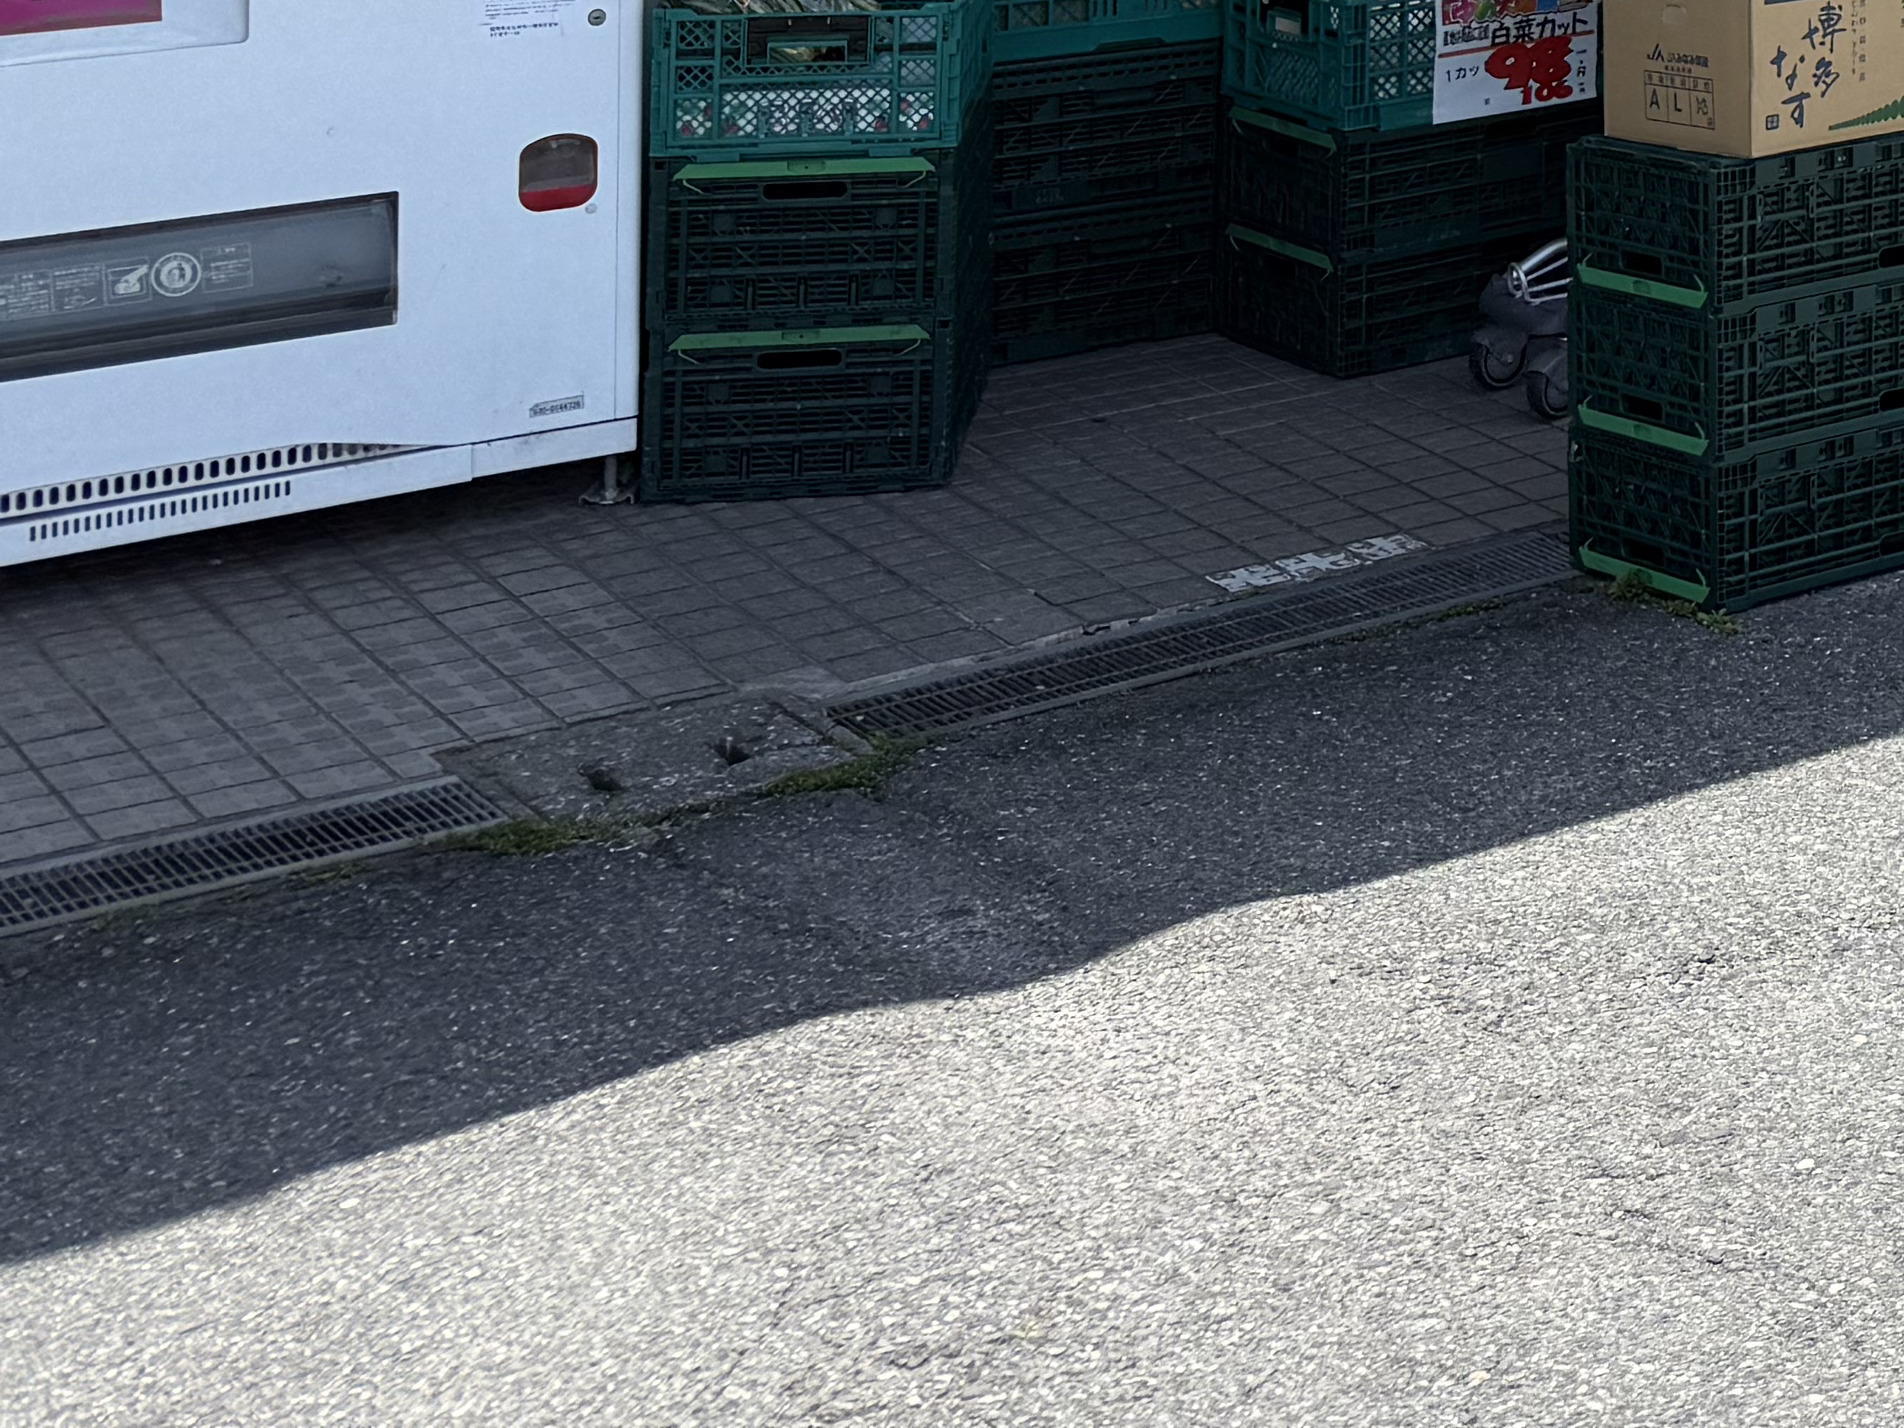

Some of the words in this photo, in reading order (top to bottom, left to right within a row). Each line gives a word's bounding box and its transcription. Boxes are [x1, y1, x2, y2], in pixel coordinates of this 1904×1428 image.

[1490, 11, 1589, 48] 白菜カット
[1484, 35, 1575, 91] 98
[1801, 0, 1847, 99] 博多
[1445, 64, 1480, 82] 1カッ
[1769, 45, 1812, 129] なす
[1649, 87, 1661, 110] A
[1673, 90, 1683, 113] L
